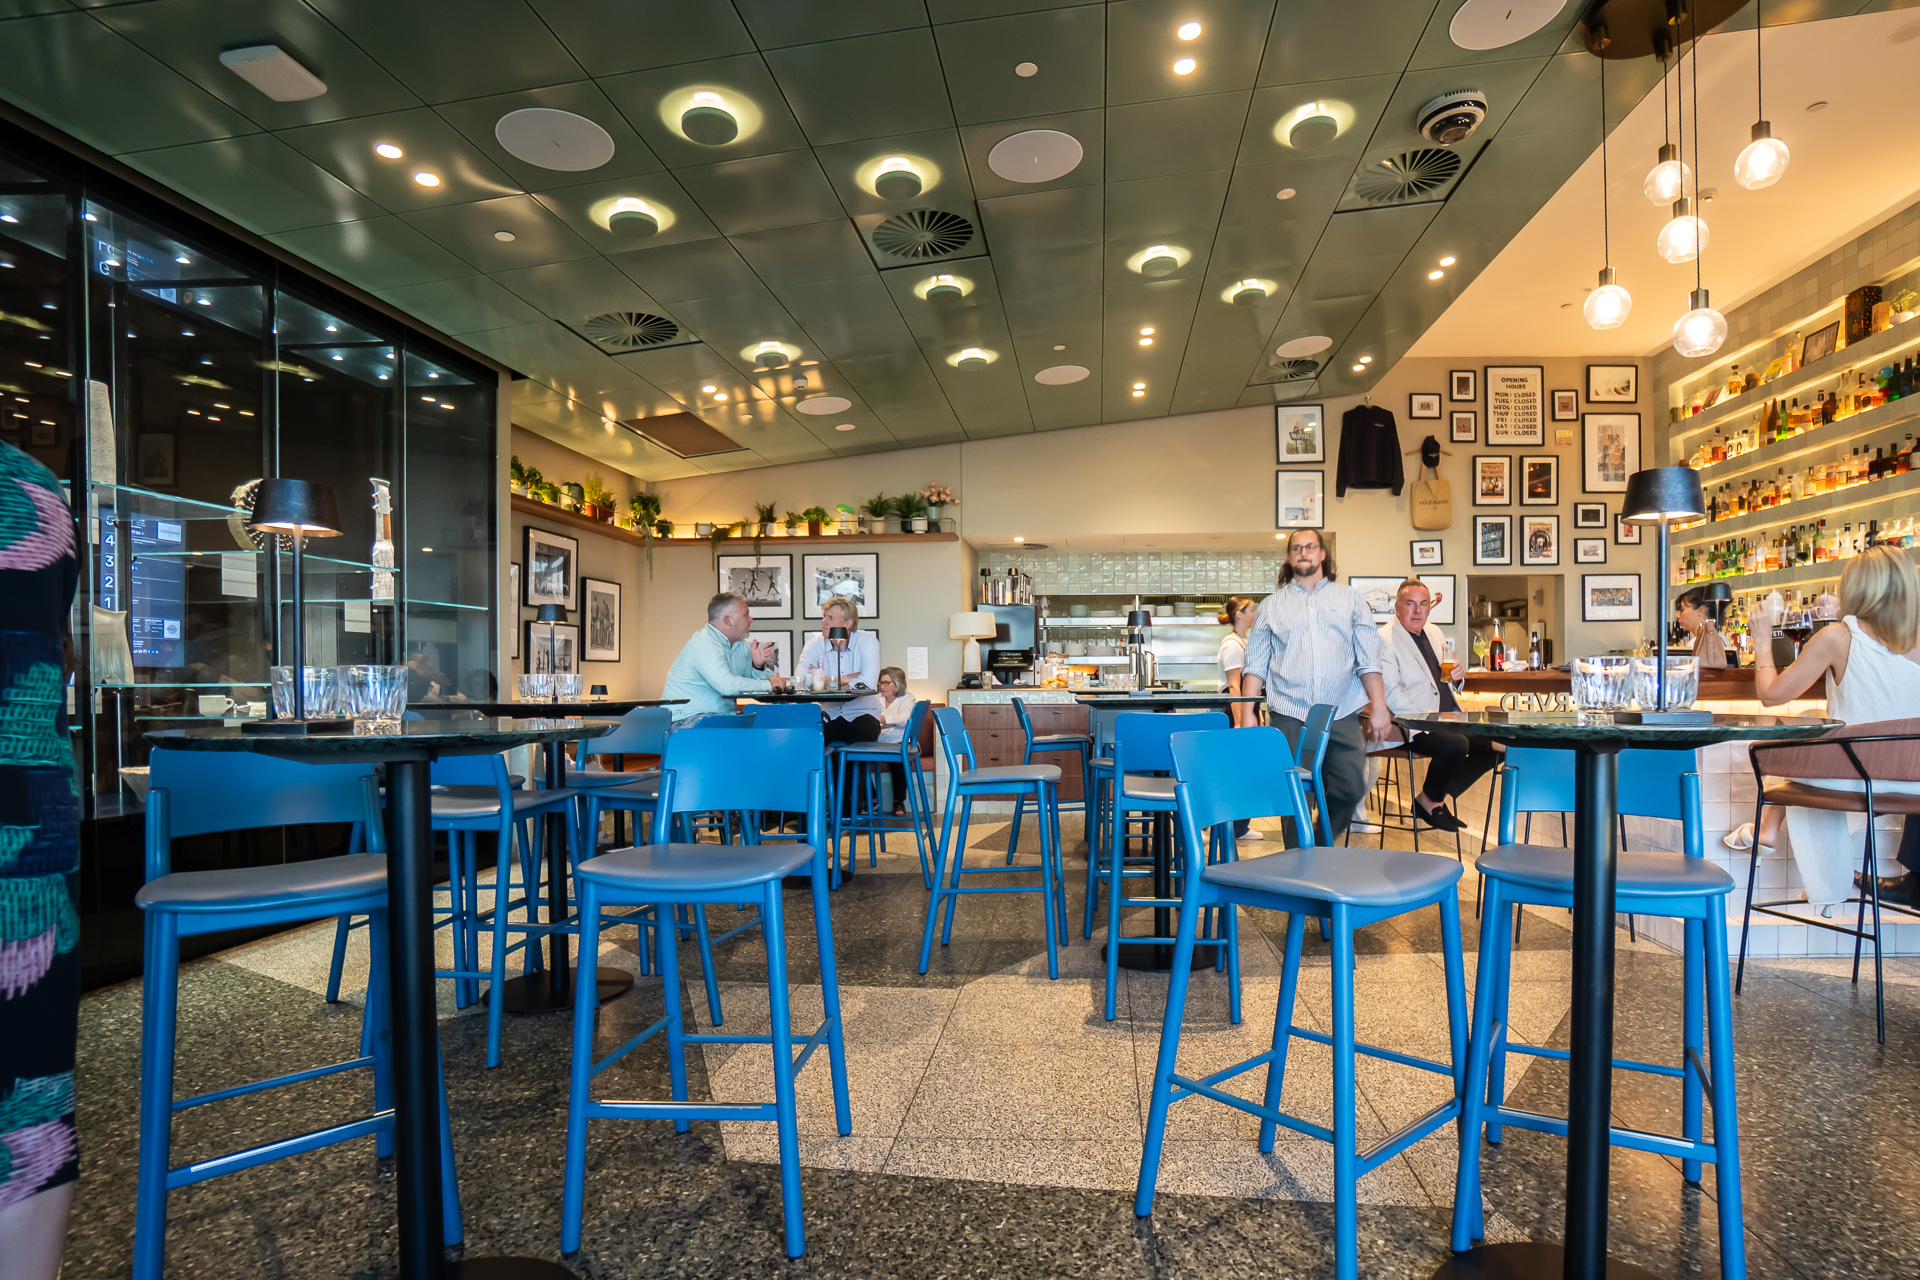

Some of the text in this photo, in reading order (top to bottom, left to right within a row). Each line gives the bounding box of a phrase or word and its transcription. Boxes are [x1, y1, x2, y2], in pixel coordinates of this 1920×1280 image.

[104, 534, 116, 546] 4
[104, 555, 114, 567] 3
[104, 576, 114, 588] 2
[104, 596, 111, 608] 1
